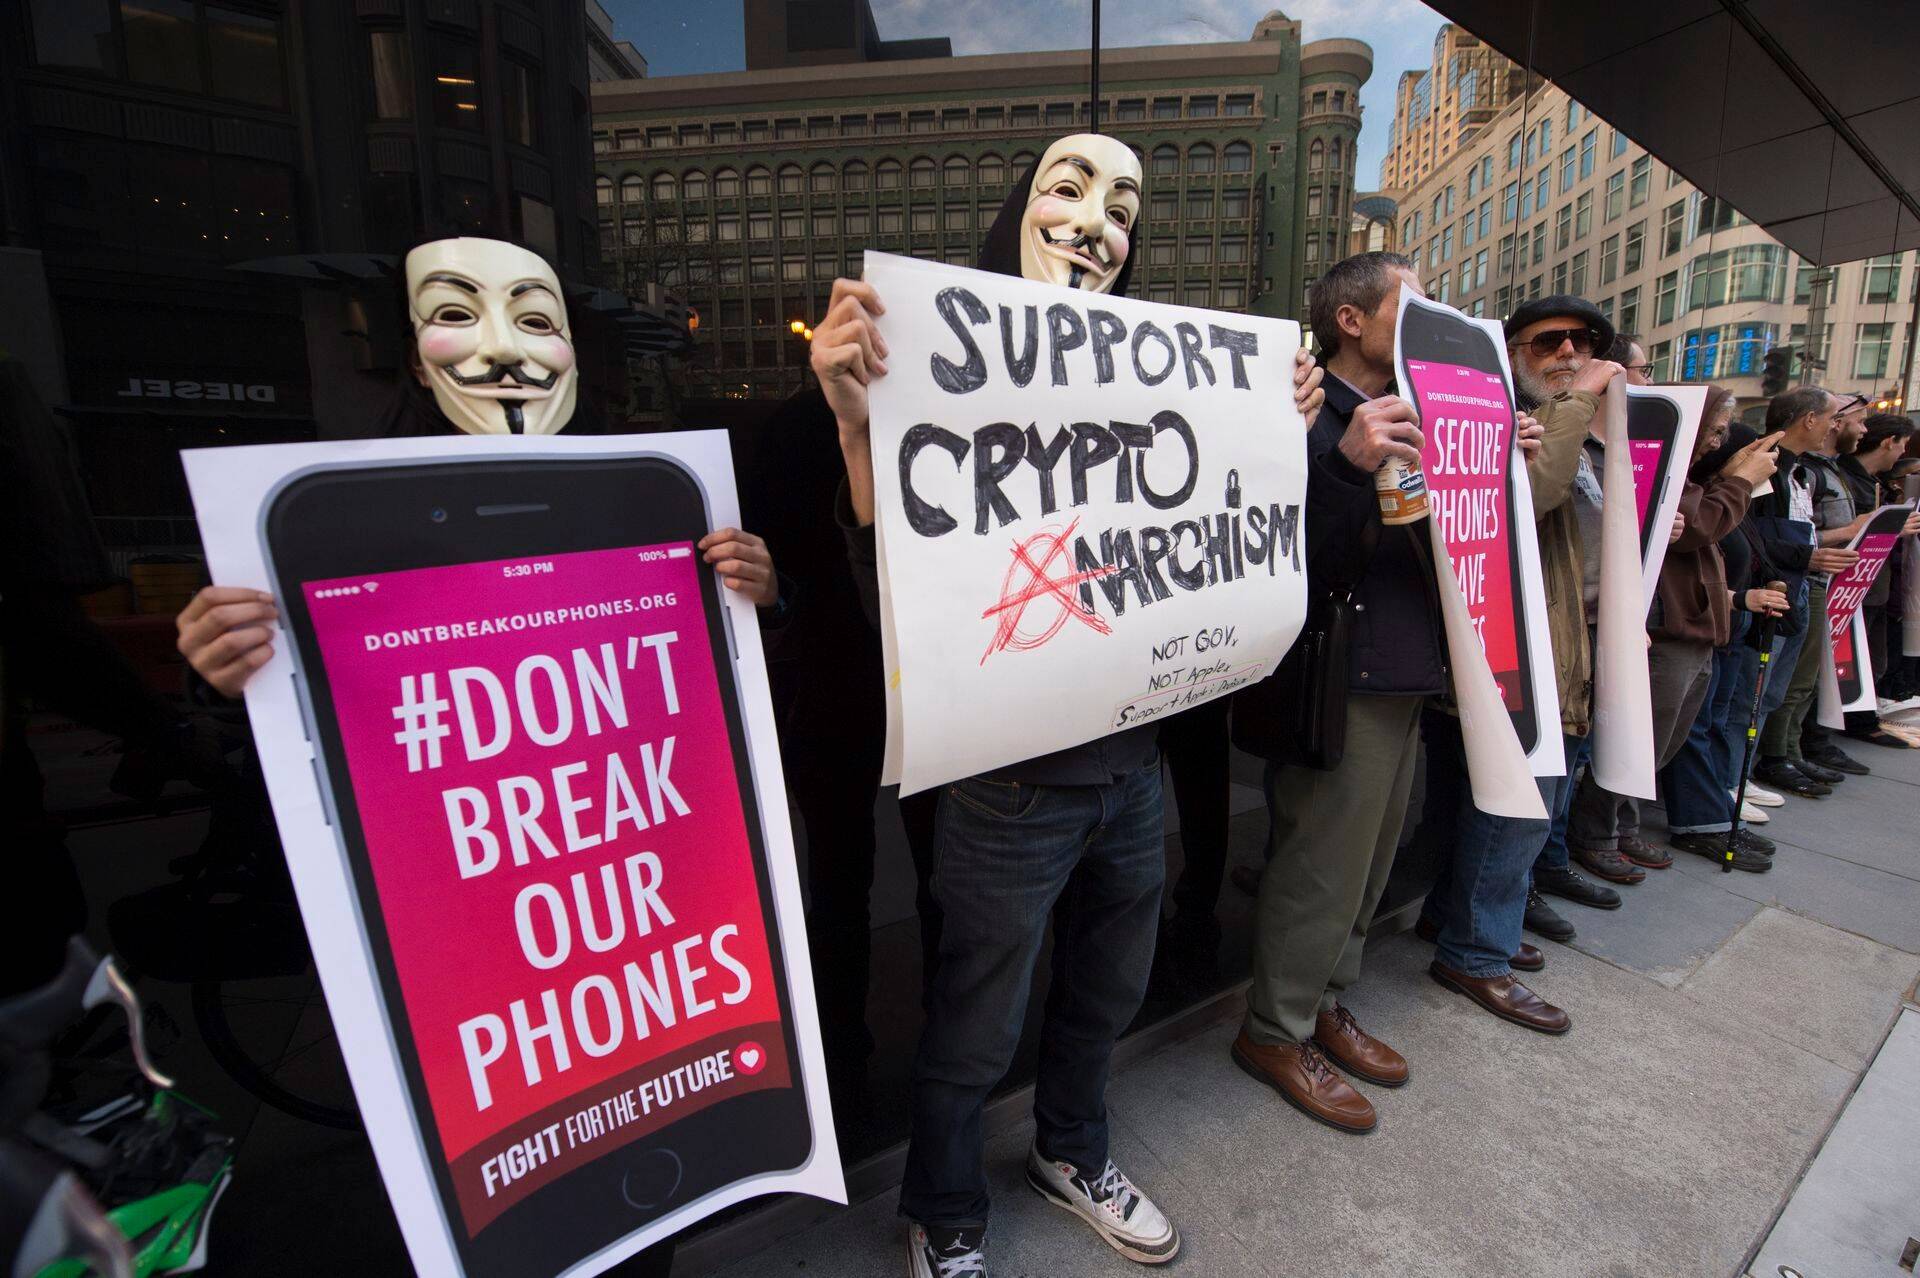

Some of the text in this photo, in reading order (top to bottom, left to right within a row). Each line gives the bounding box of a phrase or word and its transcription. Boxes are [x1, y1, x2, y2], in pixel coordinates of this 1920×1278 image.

[930, 286, 1258, 394] SUPPORT
[898, 410, 1198, 537] CRYPTO
[1432, 417, 1503, 475] SECURE
[503, 561, 555, 578] 5:30 PM
[638, 548, 666, 562] 100%
[1449, 553, 1486, 607] AVE
[364, 592, 677, 651] DONTBREAKOURPHONES.ORG
[1152, 635, 1189, 667] NOT
[392, 631, 681, 773] #DON'T
[1116, 694, 1179, 727] Support
[1148, 668, 1186, 695] NOT
[442, 736, 692, 880] BREAK
[514, 850, 676, 970] OUR
[458, 924, 752, 1112] PHONES
[480, 1122, 560, 1198] FIGHT
[638, 1049, 735, 1115] FUTURE
